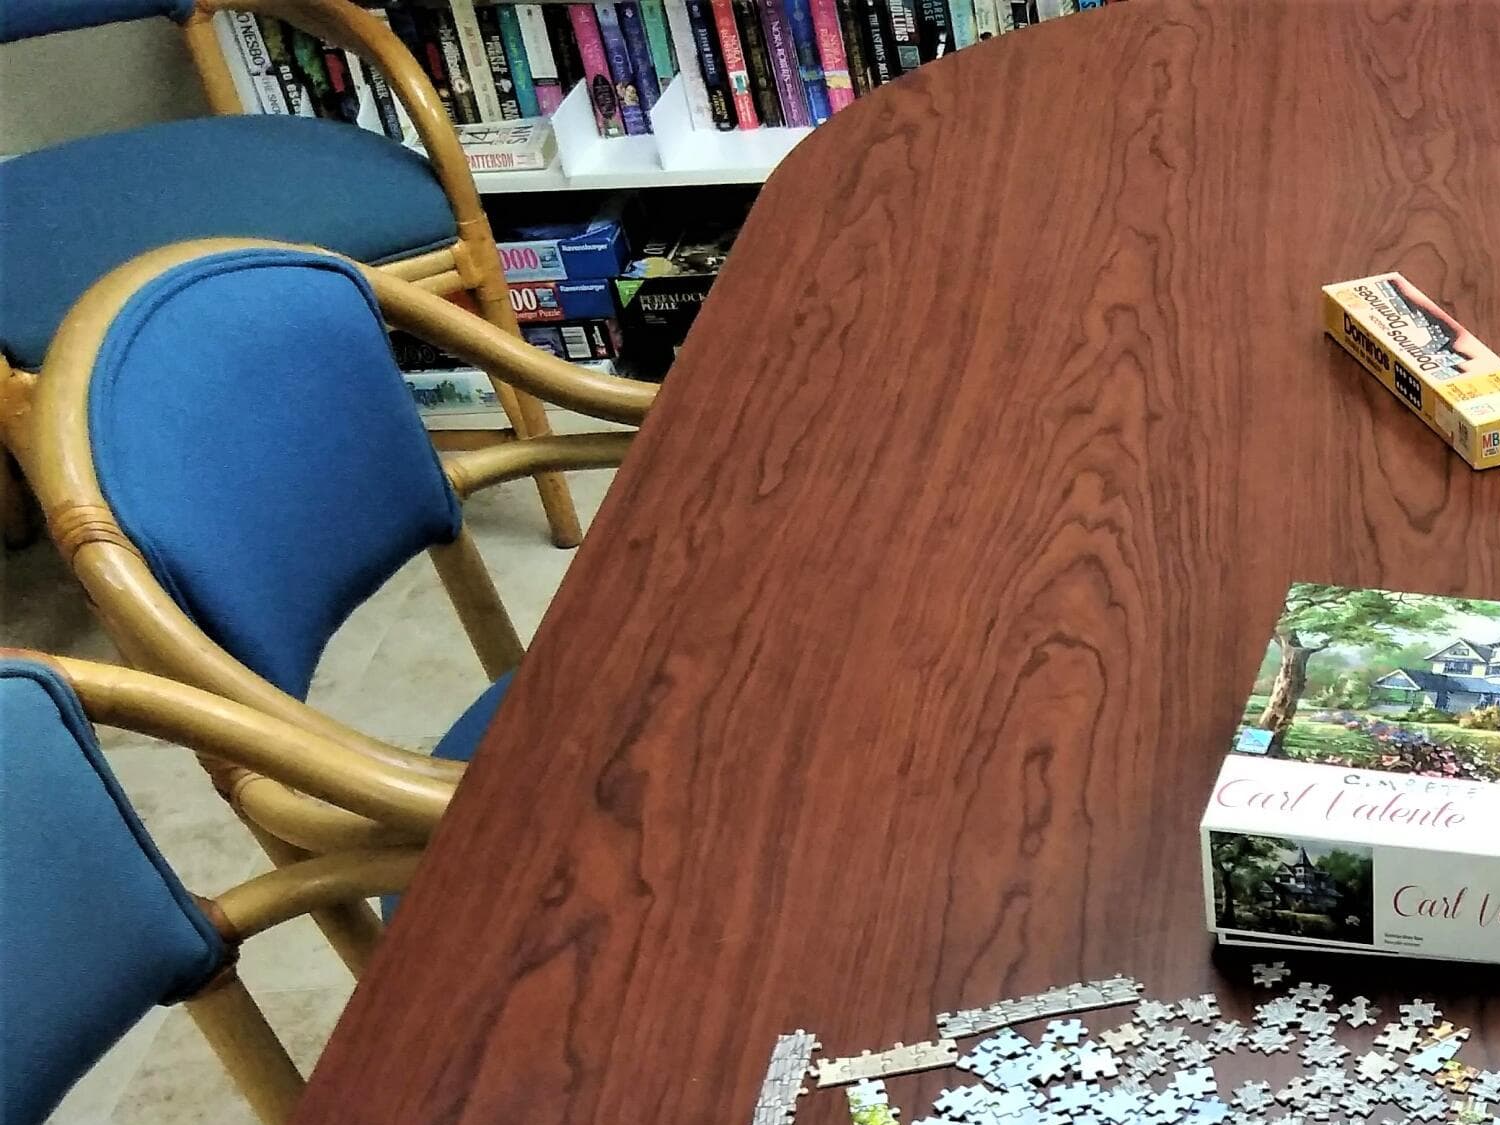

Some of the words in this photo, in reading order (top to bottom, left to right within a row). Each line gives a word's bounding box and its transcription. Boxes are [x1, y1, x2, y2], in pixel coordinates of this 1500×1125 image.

[932, 0, 947, 26] AREN
[769, 21, 783, 48] NORA
[731, 34, 742, 64] NORA
[562, 242, 608, 254] Ravensburger
[560, 282, 606, 294] Ravensburger
[641, 302, 680, 312] PUZZLE
[1354, 285, 1408, 330] Dominoes
[1389, 329, 1441, 372] Dominos
[1482, 431, 1500, 450] MB
[1216, 778, 1313, 812] Carl
[1325, 789, 1466, 829] Valente
[1393, 884, 1470, 919] Carl
